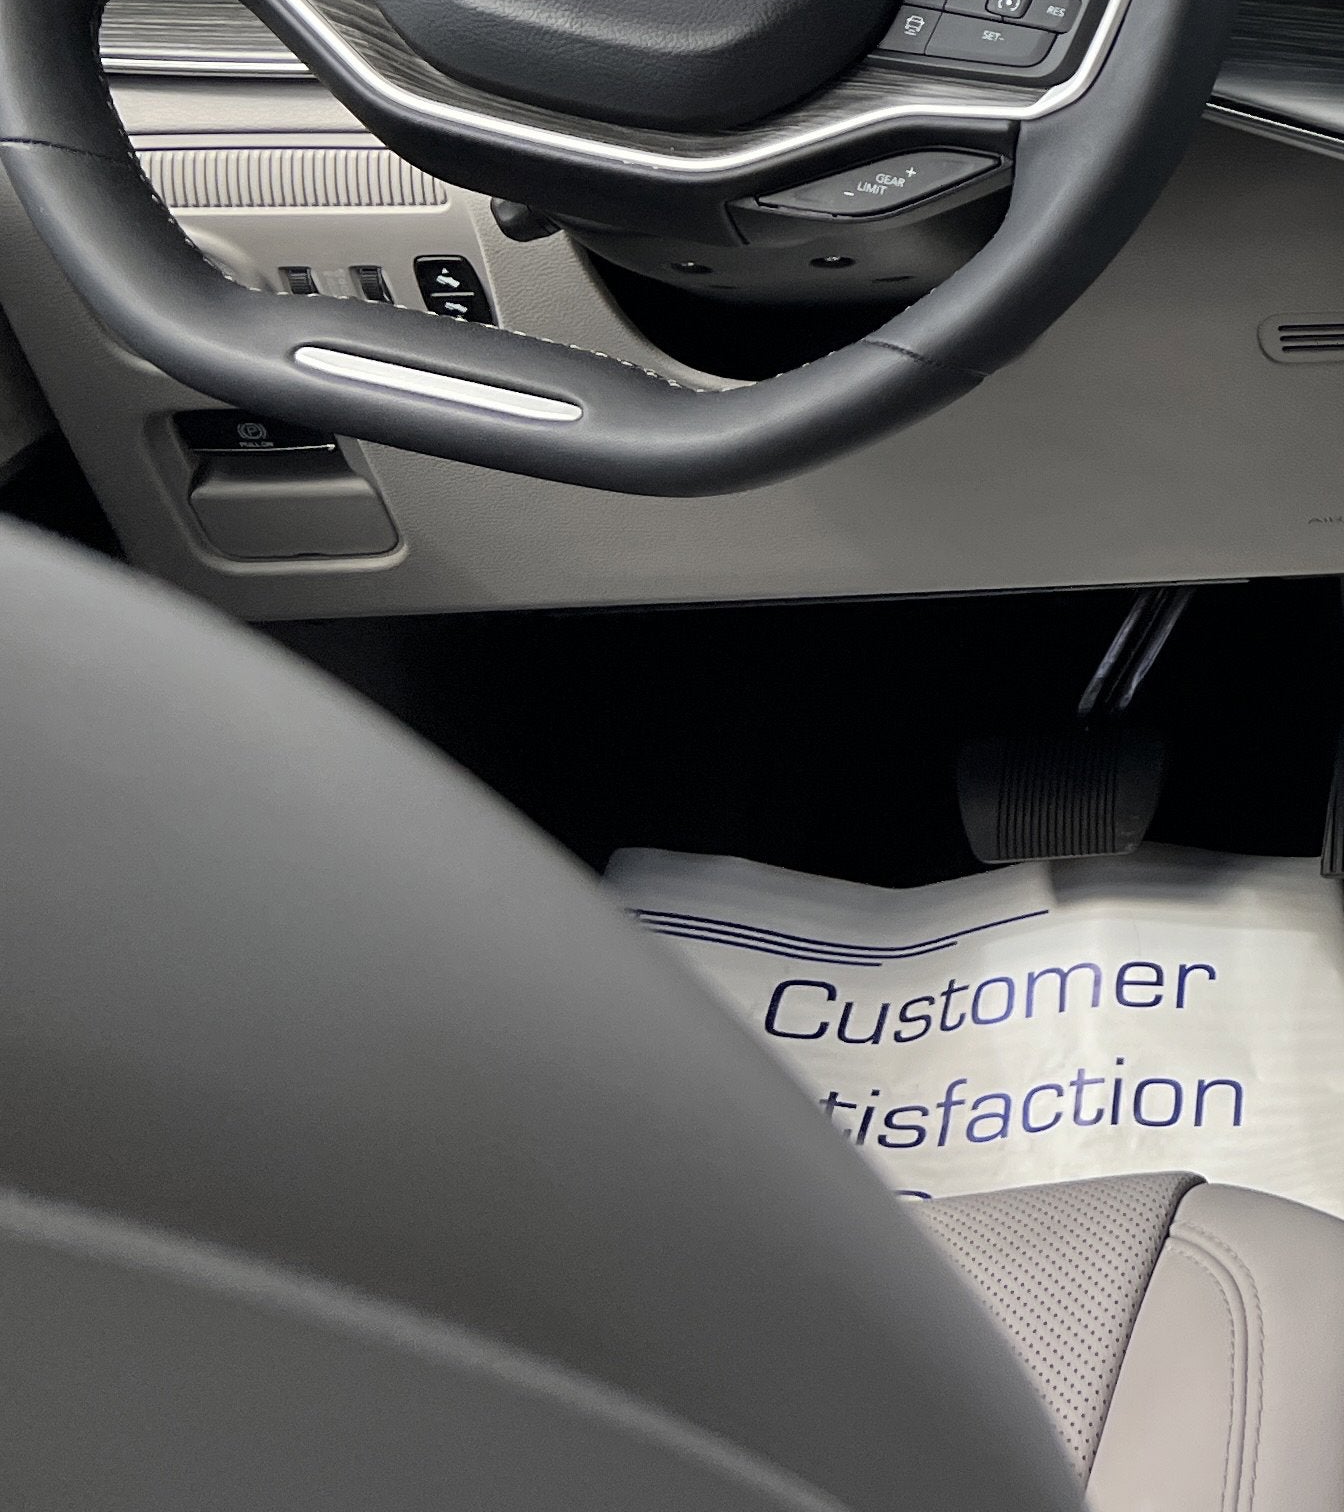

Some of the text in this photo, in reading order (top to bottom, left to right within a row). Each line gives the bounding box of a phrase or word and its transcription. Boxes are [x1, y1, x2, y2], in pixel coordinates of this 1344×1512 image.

[1046, 5, 1066, 18] RES
[875, 173, 906, 188] GEAR
[857, 181, 888, 196] LIMIT
[764, 960, 1217, 1045] Customer
[819, 1056, 1244, 1149] tisfaction
